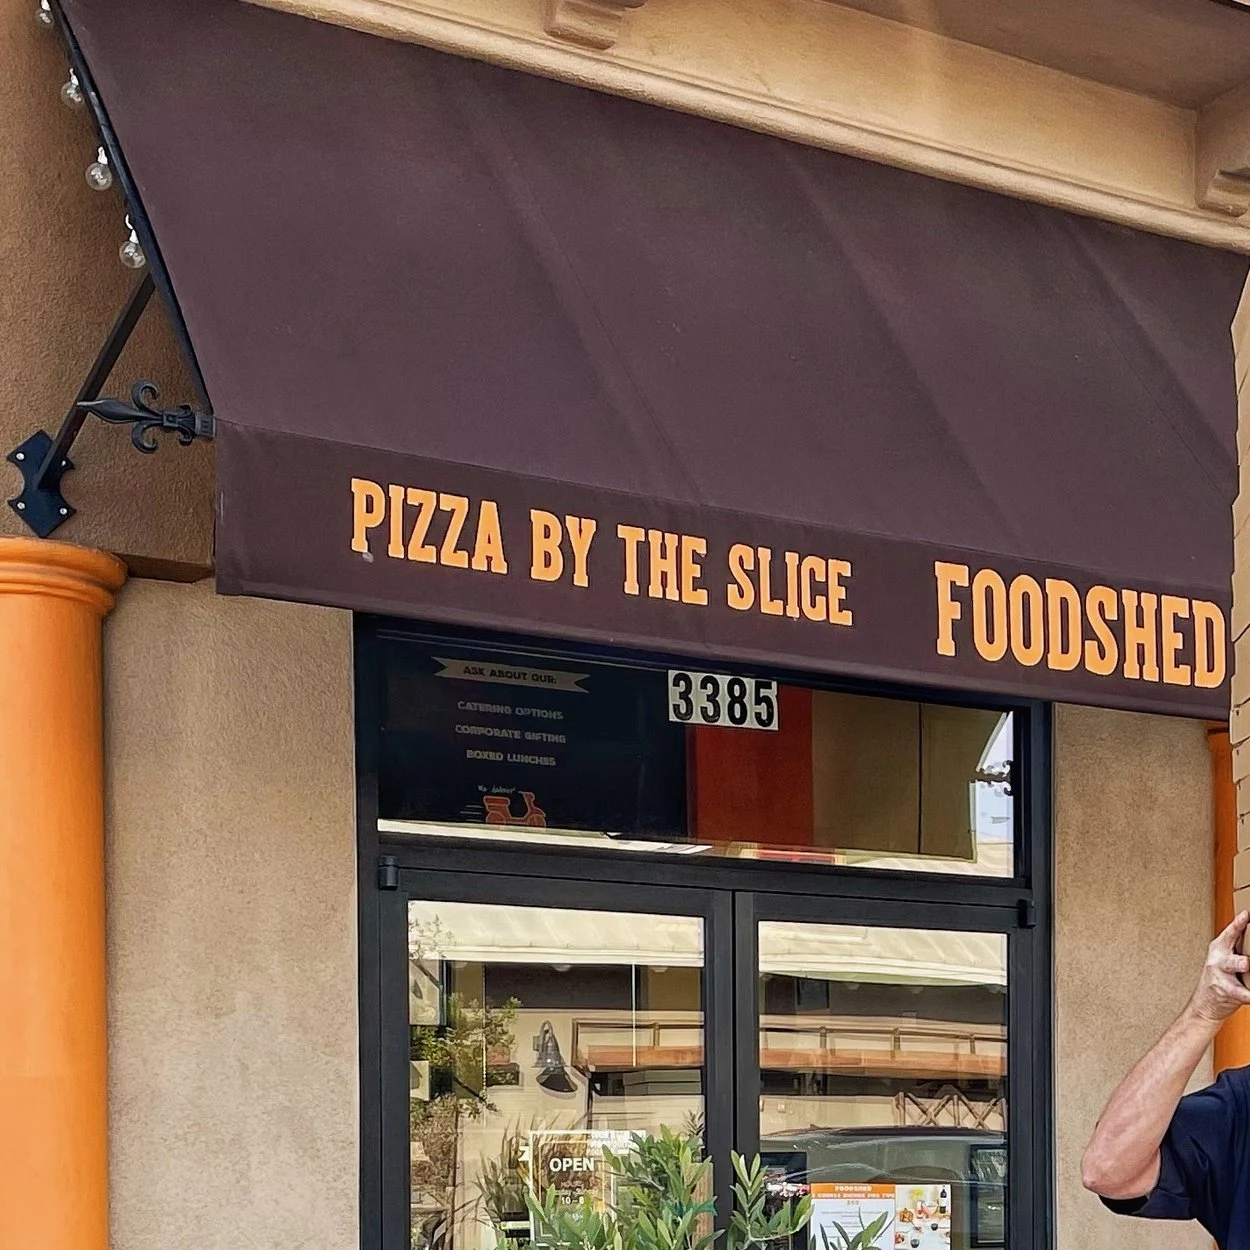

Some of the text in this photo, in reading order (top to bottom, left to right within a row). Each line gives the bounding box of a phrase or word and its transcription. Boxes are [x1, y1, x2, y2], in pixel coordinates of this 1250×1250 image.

[351, 478, 853, 626] PIZZA BY THE SLICE
[934, 560, 1226, 689] FOODSHED
[463, 665, 486, 677] ASK
[489, 668, 529, 681] ABOUT
[672, 672, 775, 727] 3385
[457, 700, 564, 720] CATERING OPTIONS
[454, 724, 567, 744] CORPORATE GIFTING
[465, 749, 557, 767] BOXED LUNCHES
[549, 1157, 595, 1172] OPEN
